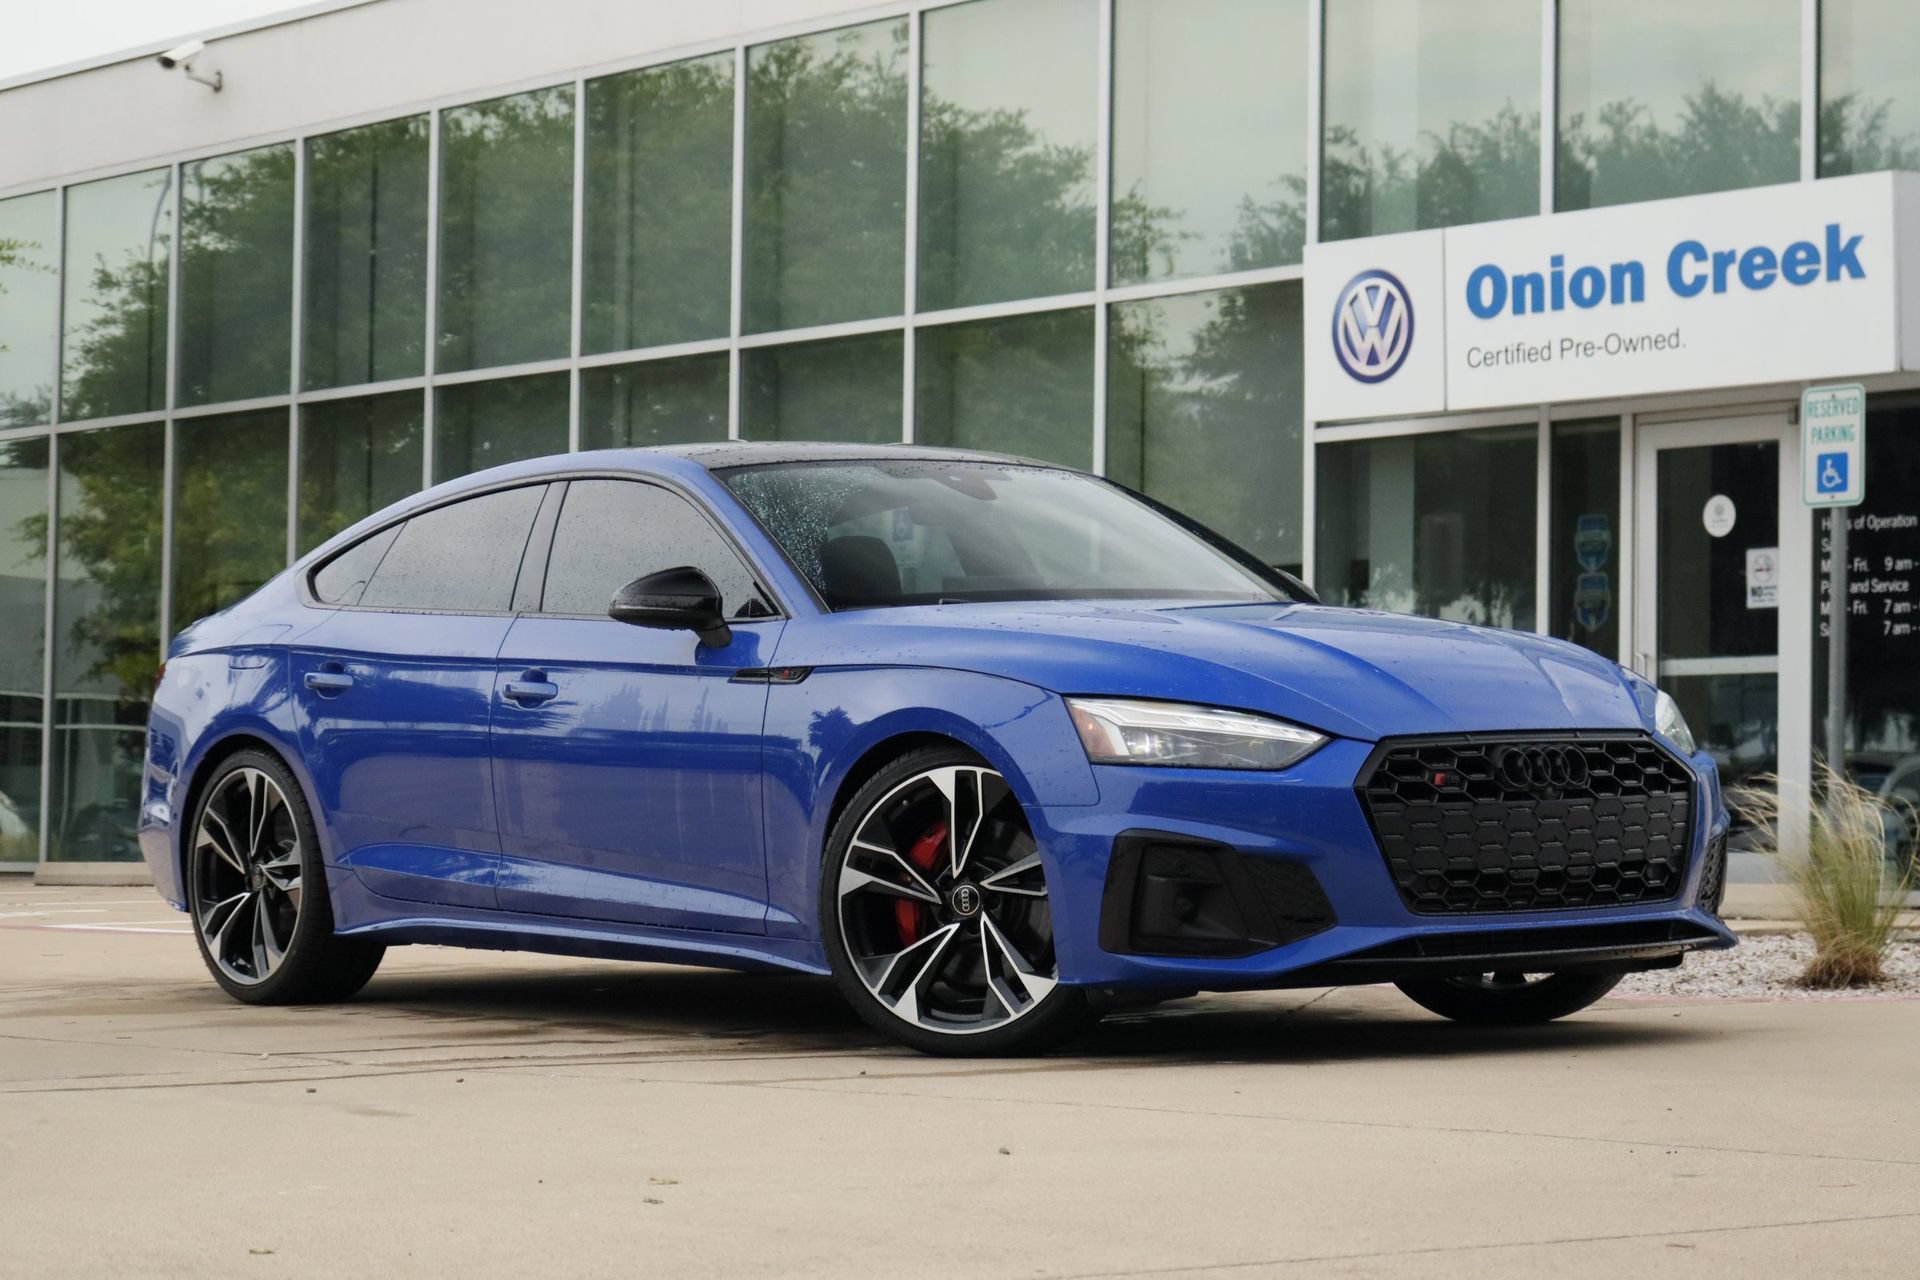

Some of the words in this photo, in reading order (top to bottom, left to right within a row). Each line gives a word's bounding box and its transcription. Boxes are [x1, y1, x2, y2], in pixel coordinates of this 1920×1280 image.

[1465, 254, 1645, 320] Onion
[1666, 223, 1866, 298] Creek
[1466, 340, 1552, 369] Certified
[1560, 327, 1687, 360] Pre-Owned.
[1807, 397, 1859, 418] RESERVED
[1811, 423, 1855, 444] PARKING
[1866, 513, 1919, 532] Operation
[1884, 555, 1894, 572] 9
[1894, 557, 1913, 571] am
[1849, 578, 1870, 594] and
[1870, 577, 1910, 593] Service
[1883, 598, 1892, 614] 7
[1893, 601, 1911, 614] am
[1883, 619, 1892, 636] 7
[1892, 623, 1911, 635] am
